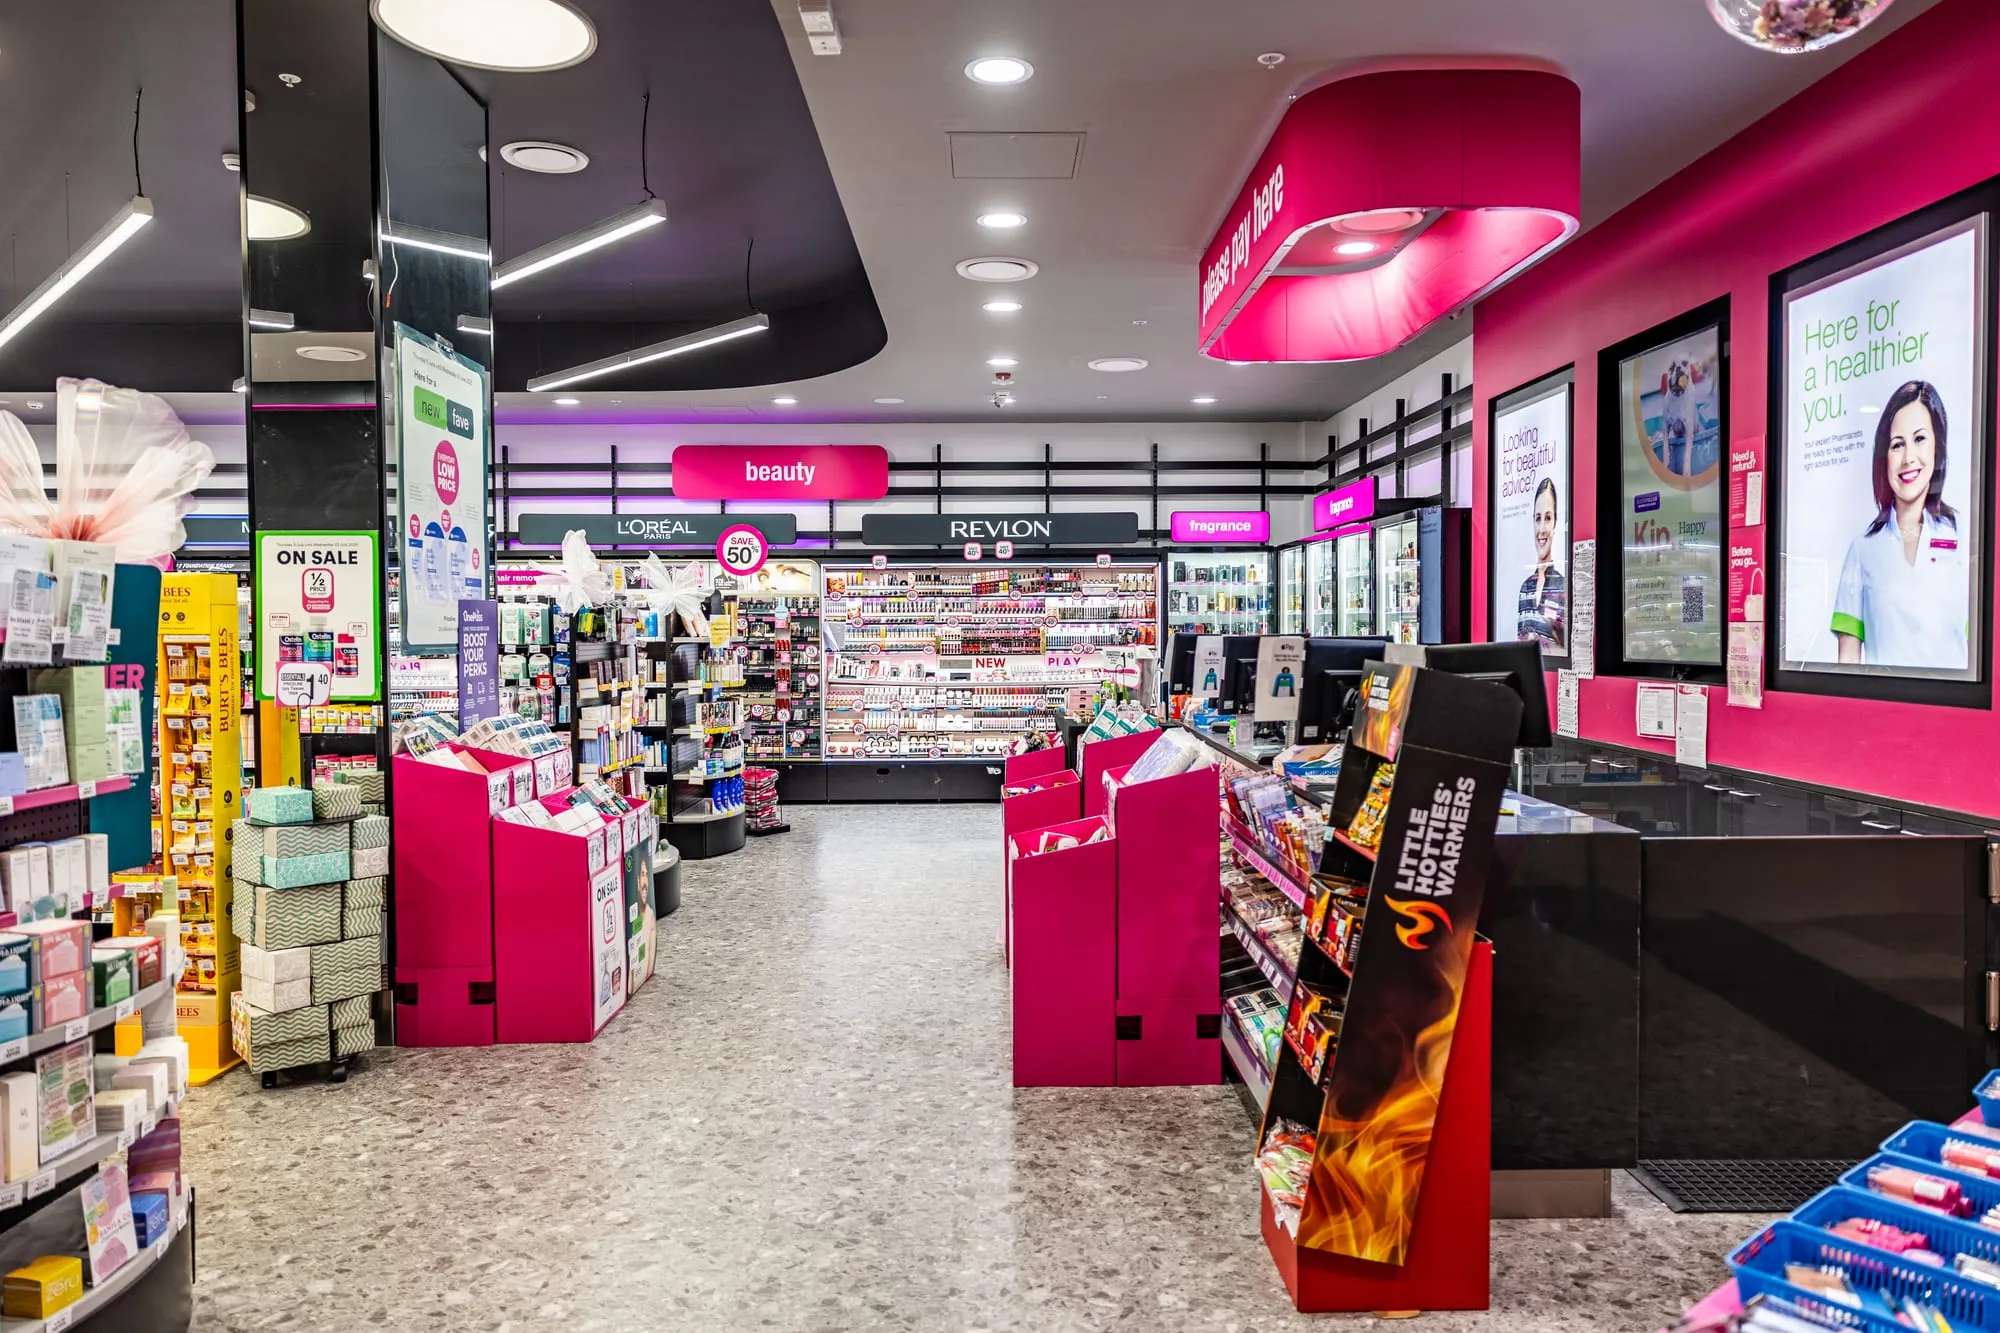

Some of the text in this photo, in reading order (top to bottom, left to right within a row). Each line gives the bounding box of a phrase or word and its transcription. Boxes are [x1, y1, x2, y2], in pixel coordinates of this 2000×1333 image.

[1202, 164, 1284, 327] please pay here
[1805, 300, 1900, 354] Here for
[1804, 331, 1929, 392] a healthier
[414, 369, 426, 383] Here
[422, 400, 470, 431] new fave
[1804, 393, 1847, 433] you.
[1504, 426, 1538, 453] Looking
[437, 452, 456, 464] EVERYDAY
[1503, 440, 1556, 476] for beautiful
[1732, 450, 1750, 463] Need
[1732, 458, 1756, 472] refund?
[438, 461, 456, 480] LOW
[746, 460, 816, 486] beauty
[438, 476, 456, 492] PRICE
[1503, 469, 1536, 498] advice?
[1330, 496, 1353, 517] fragrance
[618, 519, 696, 534] L'ORÉAL
[951, 520, 1051, 538] REVLON
[1190, 520, 1251, 534] fragrance
[1679, 520, 1706, 536] Happy
[277, 551, 358, 564] ON SALE
[1731, 547, 1752, 557] Before
[1731, 559, 1743, 570] you
[164, 587, 191, 597] BEES
[463, 608, 483, 622] OnePass
[464, 634, 487, 647] BOOST
[464, 648, 484, 662] YOUR
[976, 658, 1006, 668] NEW
[464, 662, 487, 677] PERKS
[219, 628, 229, 732] BURT'S BEES
[306, 674, 328, 700] 1 40
[1433, 776, 1476, 896] WARMERS
[1394, 808, 1428, 892] LITTLE
[596, 876, 618, 902] ON SALE
